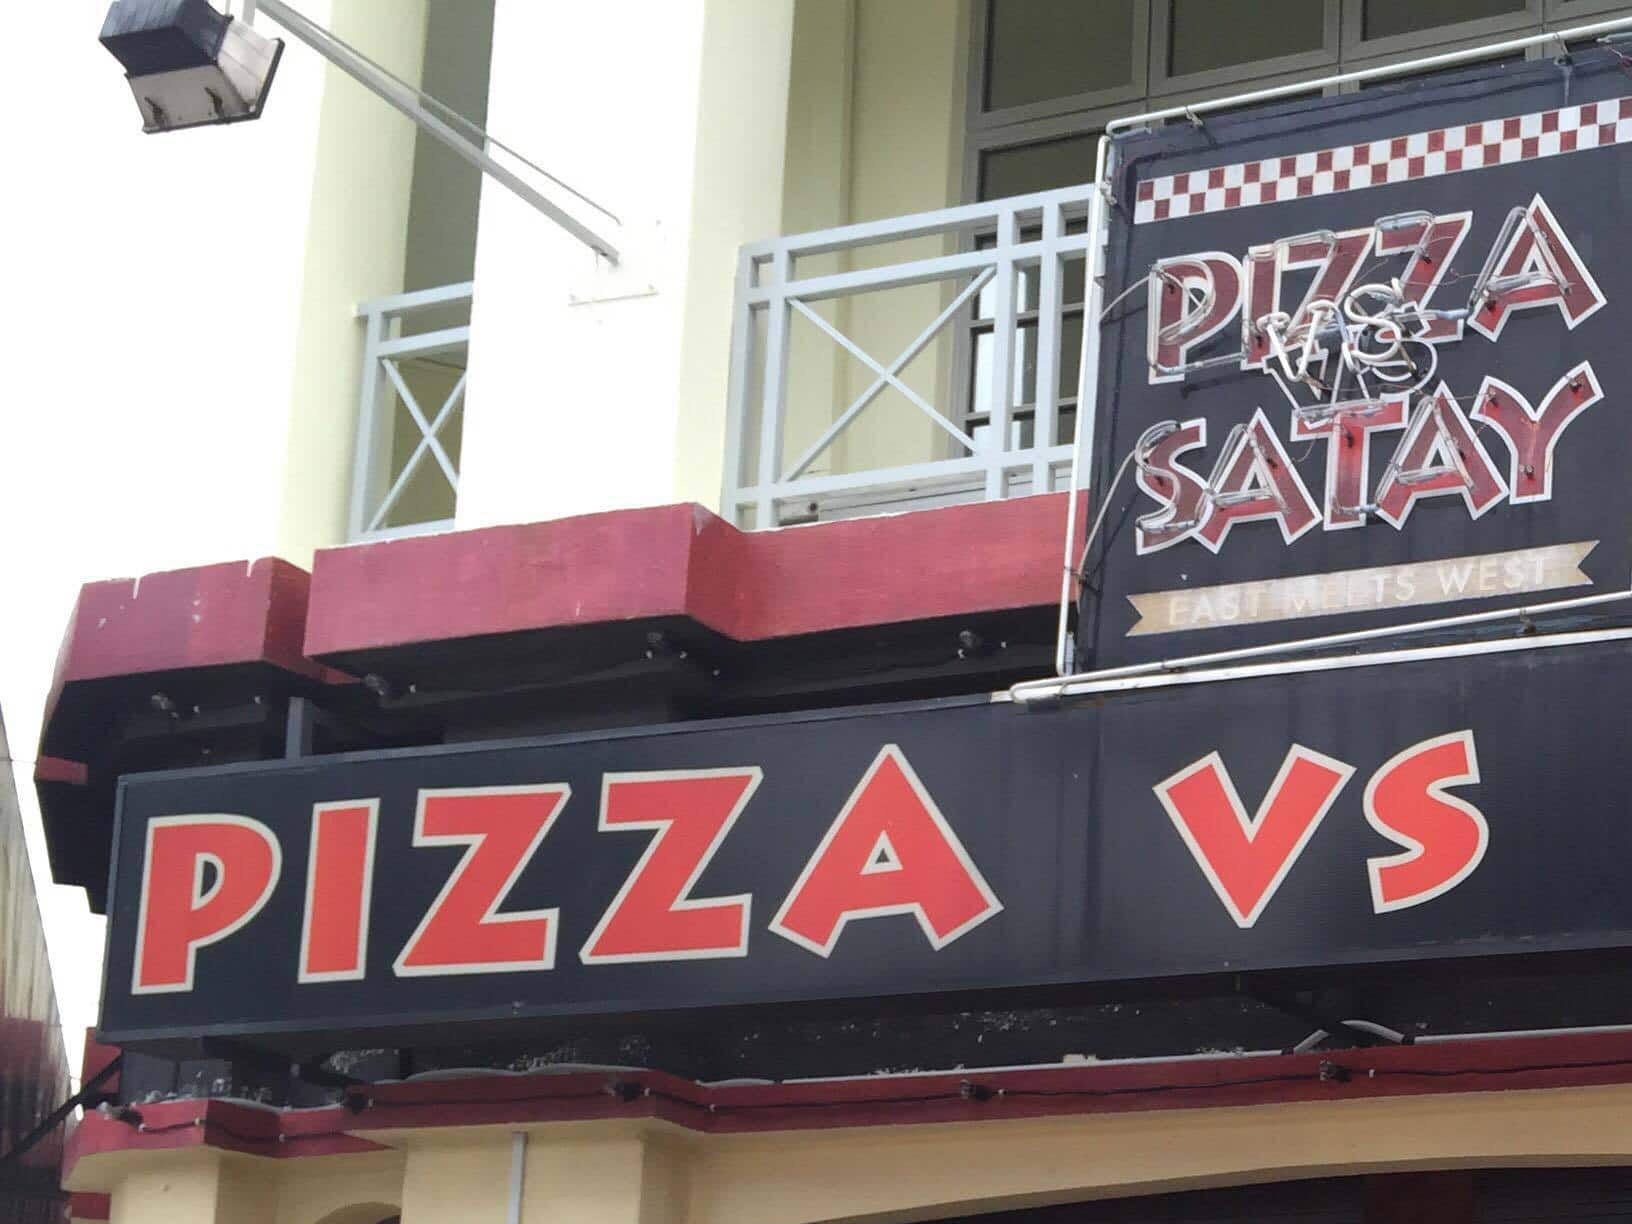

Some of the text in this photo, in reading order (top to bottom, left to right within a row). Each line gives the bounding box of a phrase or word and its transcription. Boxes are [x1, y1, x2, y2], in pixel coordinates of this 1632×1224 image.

[1147, 192, 1607, 385] PIZZA
[1136, 360, 1605, 555] SATAY
[1169, 555, 1546, 626] EAST MEETS WEST
[131, 743, 1003, 995] PIZZA
[1152, 729, 1490, 929] VS
